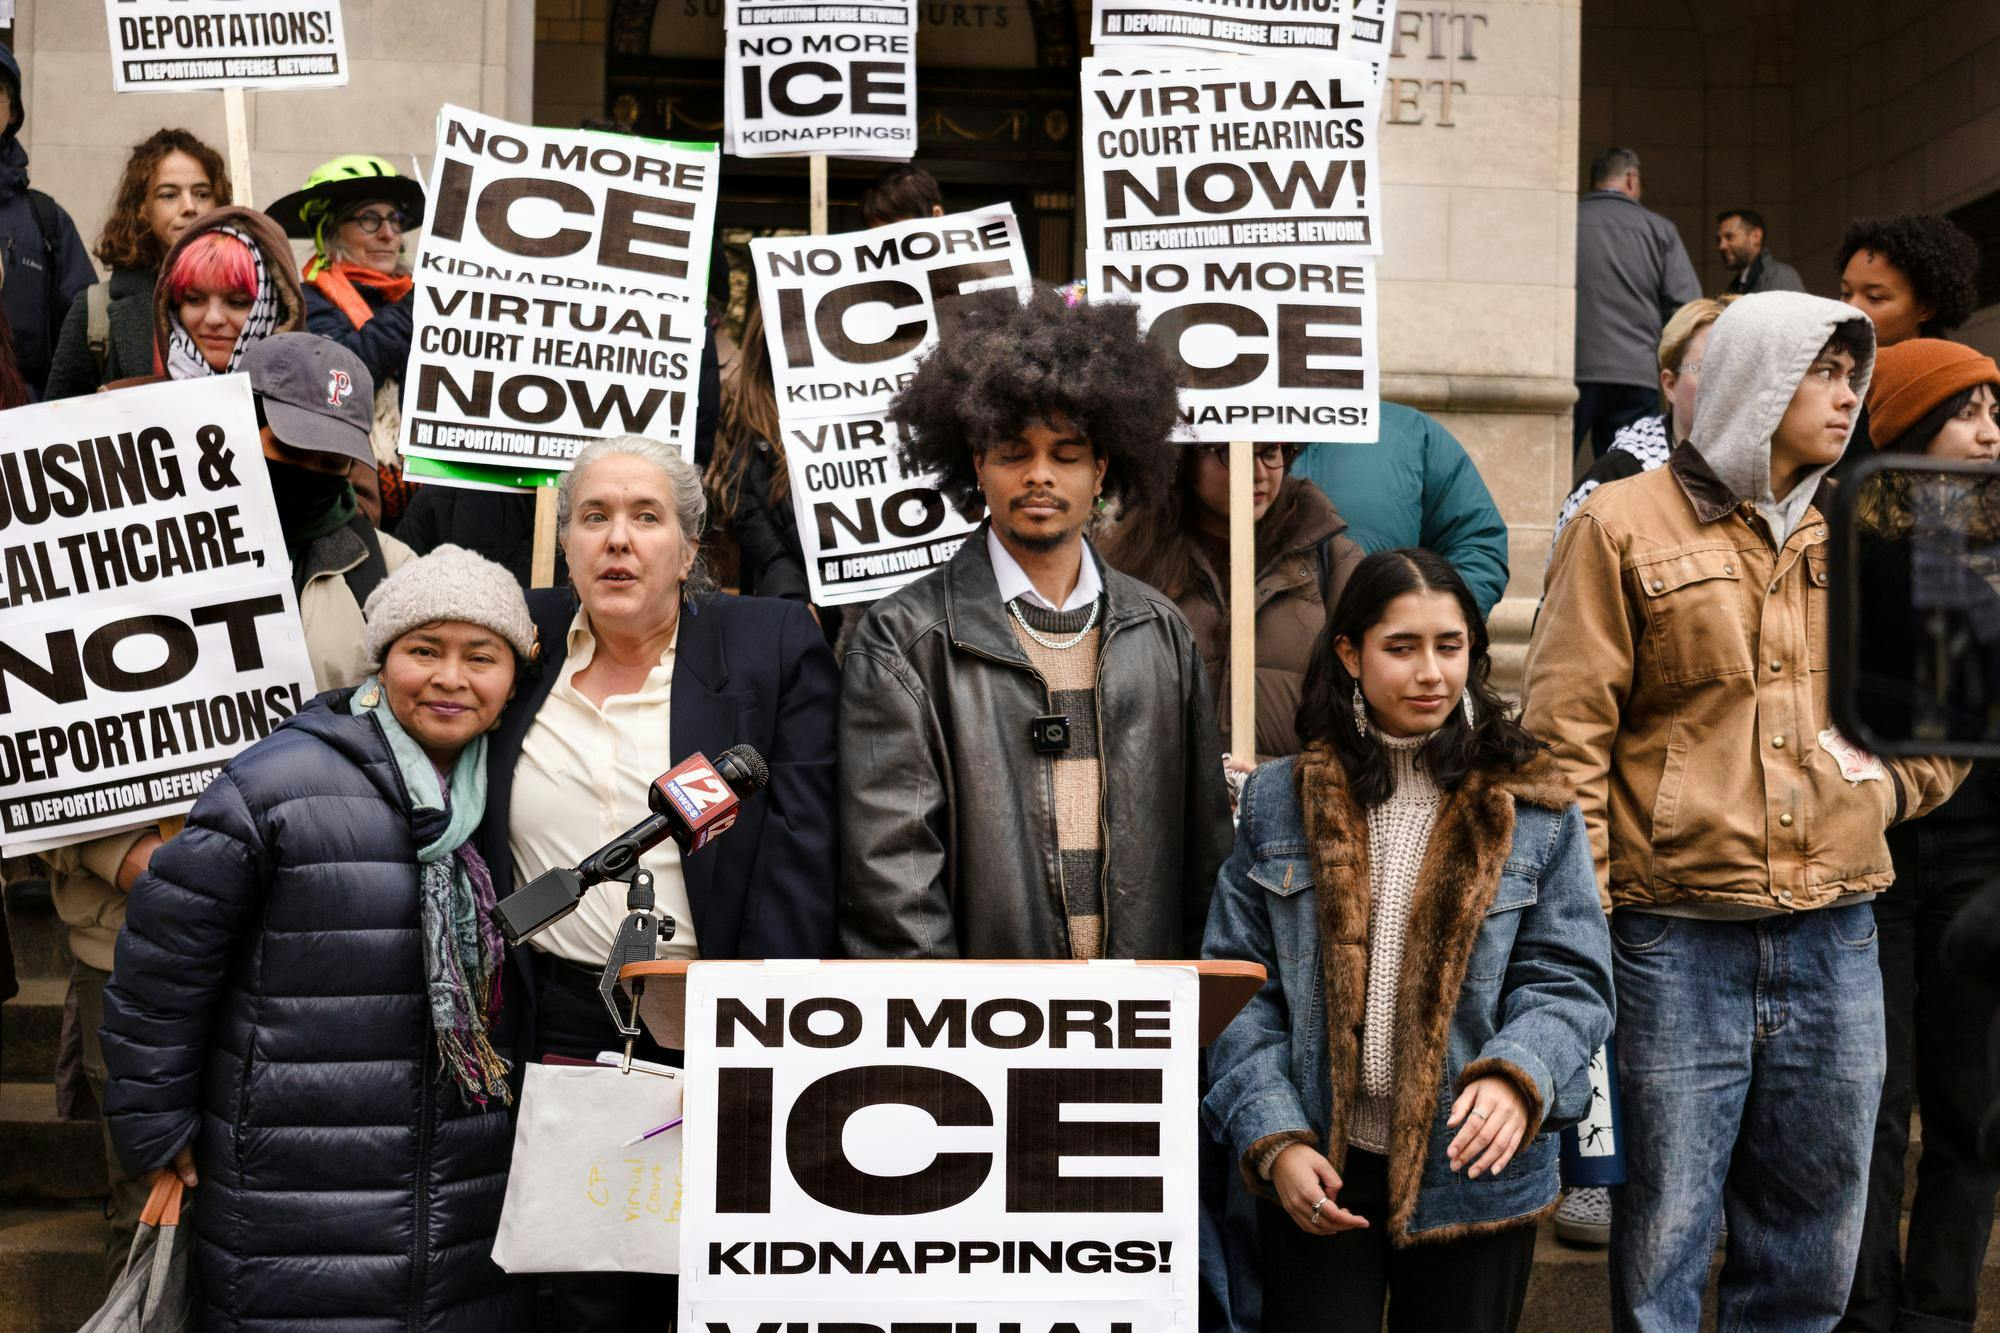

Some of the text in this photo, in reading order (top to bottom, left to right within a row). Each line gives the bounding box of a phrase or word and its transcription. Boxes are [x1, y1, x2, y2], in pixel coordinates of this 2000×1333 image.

[119, 11, 335, 50] DEPORTATIONS!
[753, 7, 816, 23] DEPORTATION
[817, 6, 859, 22] DEFENSE
[860, 8, 906, 24] NETWORK
[1107, 14, 1333, 46] RI DEPORTATION DEFENSE NETWORK
[129, 55, 334, 80] RI DEPORTATION DEFENSE NETWORK
[739, 34, 909, 57] NO MORE
[741, 60, 908, 120] ICE
[1094, 78, 1365, 120] VIRTUAL
[446, 119, 706, 192] NO MORE
[742, 126, 911, 144] KIDNAPPINGS!
[1098, 118, 1365, 159] COURT HEARINGS
[1103, 159, 1366, 220] NOW!
[431, 157, 697, 280] ICE
[1111, 221, 1365, 251] RI DEPORTATION DEFENSE NETWORK
[767, 221, 1011, 277] NO MORE
[1102, 261, 1366, 295] NO MORE
[426, 285, 692, 344] VIRTUAL
[420, 325, 689, 381] COURT HEARINGS
[1148, 302, 1365, 391] CE
[416, 363, 687, 439] NOW!
[196, 424, 242, 492] &
[417, 422, 433, 445] RI
[436, 425, 535, 455] DEPORTATION
[805, 456, 888, 492] COURT
[824, 561, 840, 581] RI
[842, 547, 930, 579] DEPORTATION
[0, 593, 286, 715] NOT
[10, 803, 30, 827] RI
[31, 781, 147, 824] DEPORTATION
[715, 996, 1173, 1050] NO MORE
[715, 1064, 1164, 1216] ICE
[708, 1240, 1173, 1275] KIDNAPPINGS!
